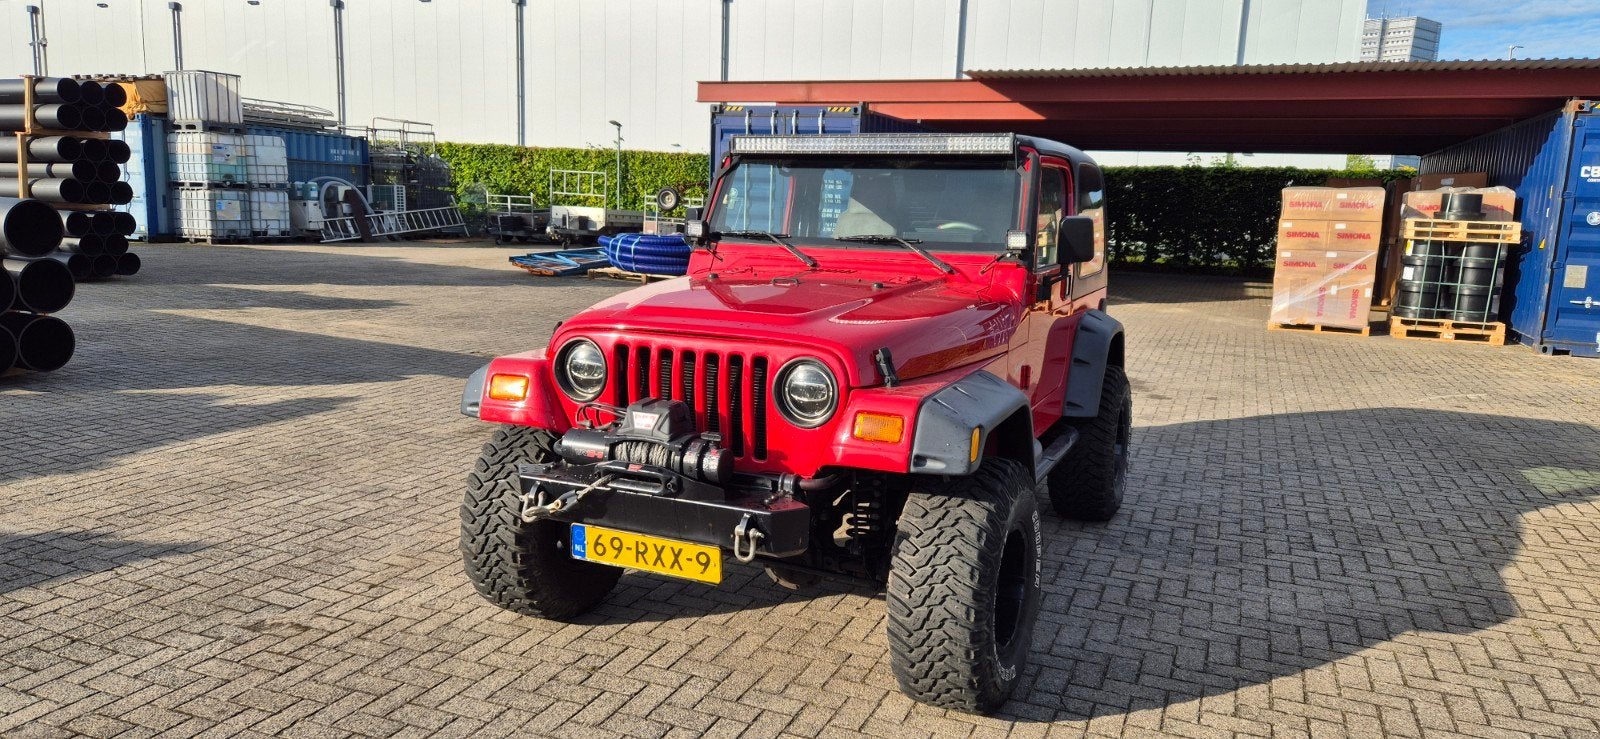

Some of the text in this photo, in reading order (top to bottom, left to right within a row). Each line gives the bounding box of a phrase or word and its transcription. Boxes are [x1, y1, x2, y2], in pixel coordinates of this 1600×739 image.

[1286, 231, 1319, 239] SIMONA
[1337, 232, 1371, 240] SIMONA
[1283, 260, 1316, 268] SIMONA
[1316, 287, 1326, 317] SIMONA
[1349, 289, 1359, 319] SIMONA
[574, 533, 711, 575] NL 69-RXX-9
